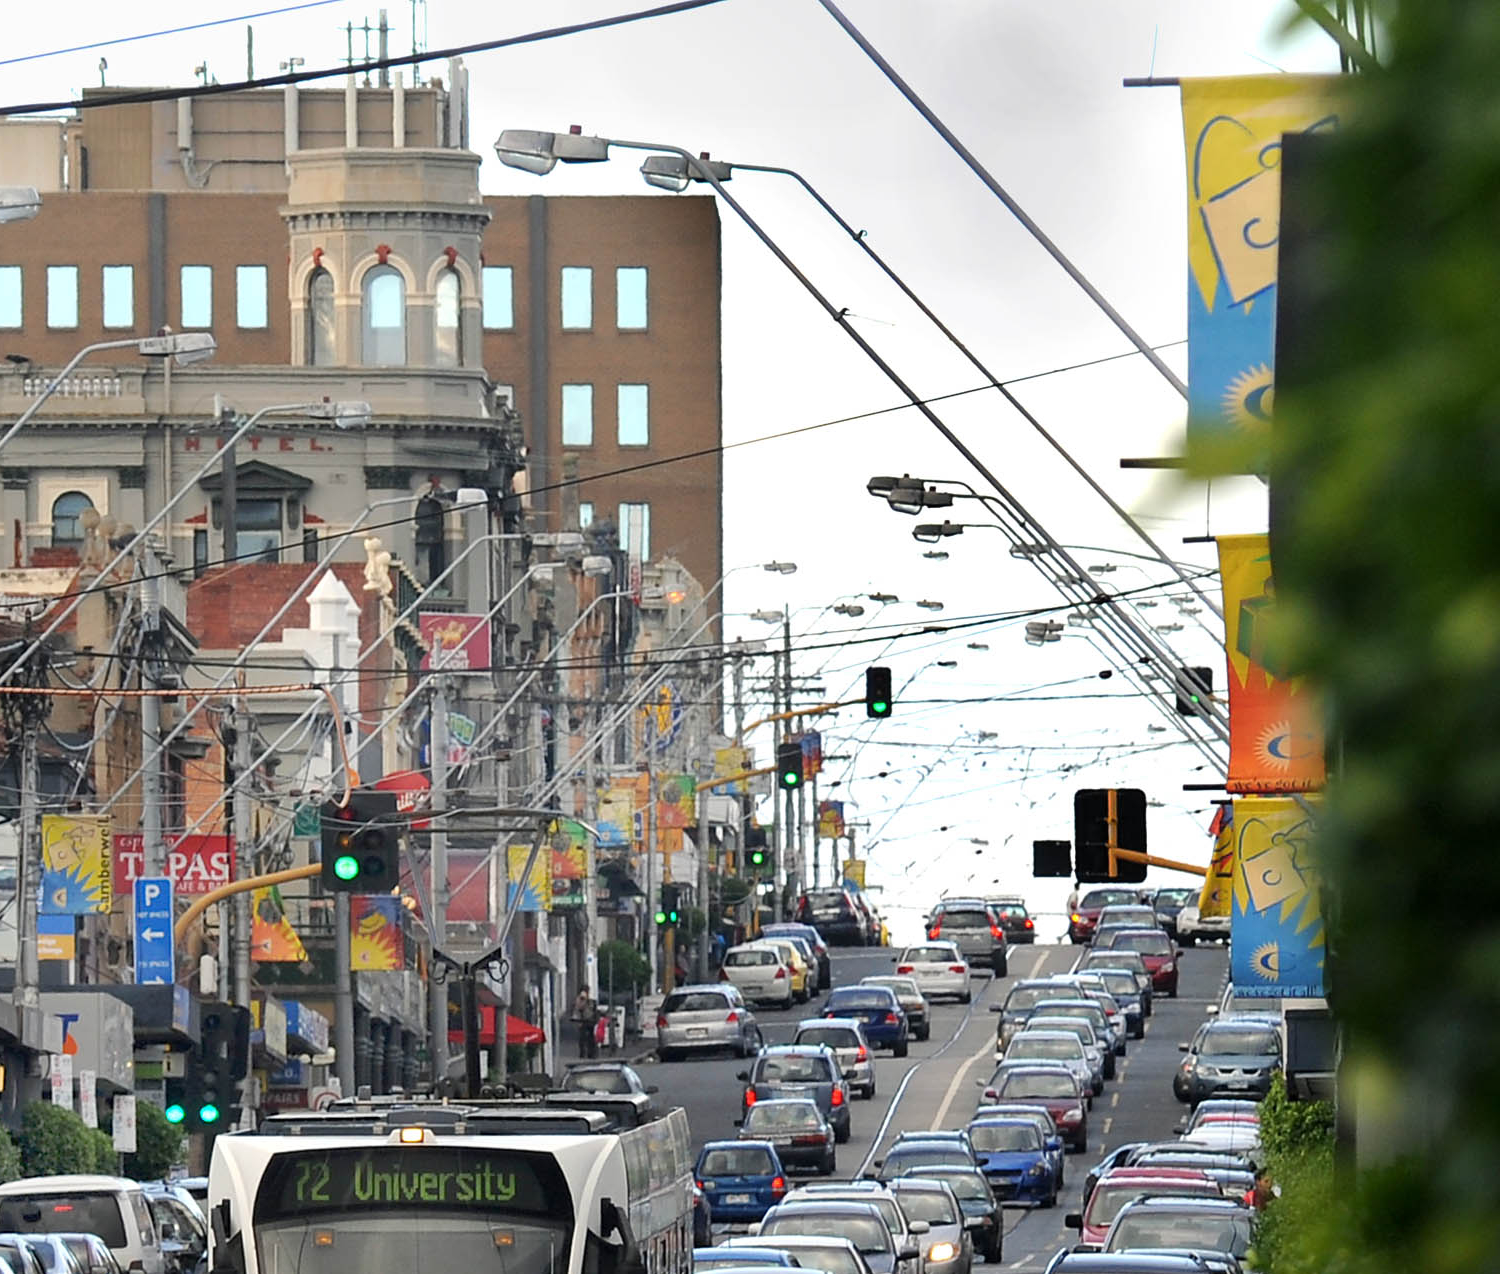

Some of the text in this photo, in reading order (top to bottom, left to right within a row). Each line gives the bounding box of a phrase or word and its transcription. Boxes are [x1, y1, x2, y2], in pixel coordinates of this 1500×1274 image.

[119, 852, 229, 880] TPAS
[145, 884, 160, 907] P
[295, 1160, 516, 1201] 72 University
